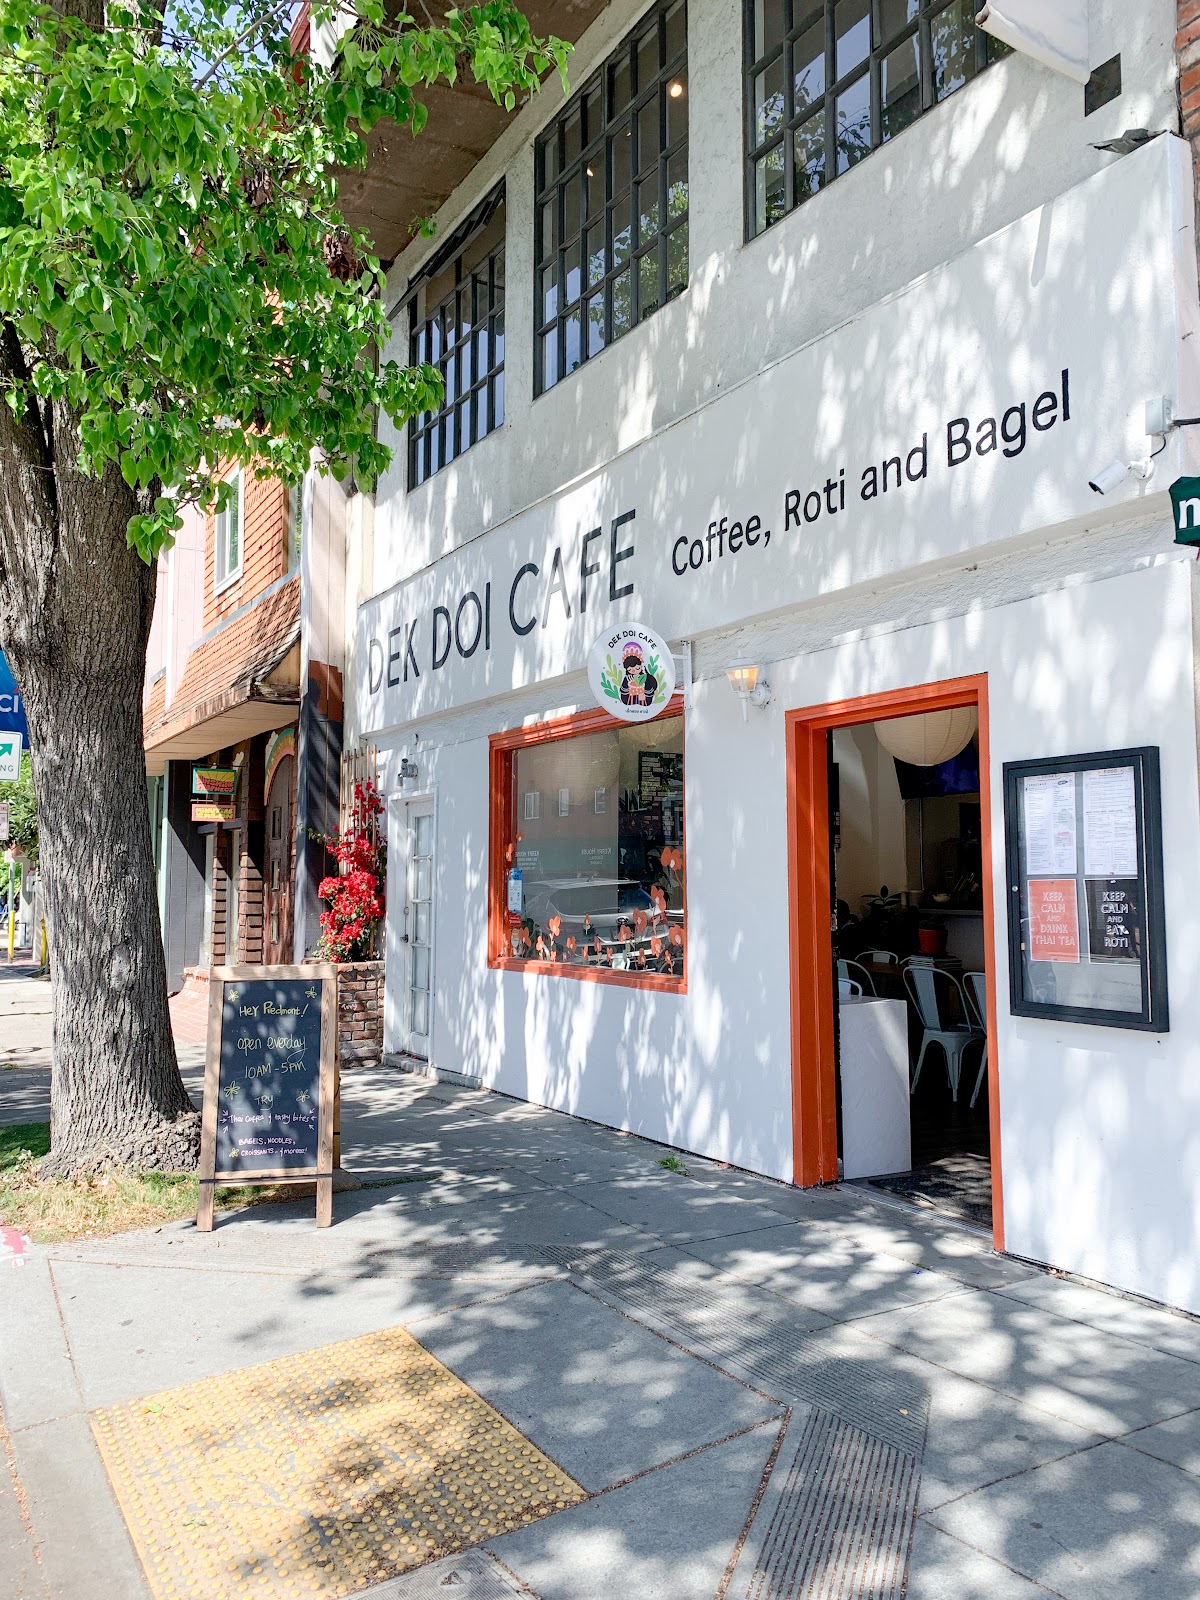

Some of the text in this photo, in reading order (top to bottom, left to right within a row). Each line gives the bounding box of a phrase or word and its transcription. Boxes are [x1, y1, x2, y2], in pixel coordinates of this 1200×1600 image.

[671, 368, 1071, 576] Coffee, Roti and Bagel
[368, 508, 637, 696] DEK DOI CAFE
[608, 630, 657, 649] DEK DOI CAFE
[1102, 891, 1126, 902] KEEP
[1041, 903, 1066, 913] CALM
[1100, 903, 1129, 914] CALM
[1107, 915, 1124, 923] AND
[1040, 923, 1069, 934] DRINK
[1033, 934, 1076, 946] THAI TEA
[1104, 937, 1129, 948] ROTI
[244, 1063, 272, 1079] 10AM
[280, 1061, 307, 1074] 5PM
[227, 1114, 244, 1123] Thai
[293, 1112, 310, 1123] bites
